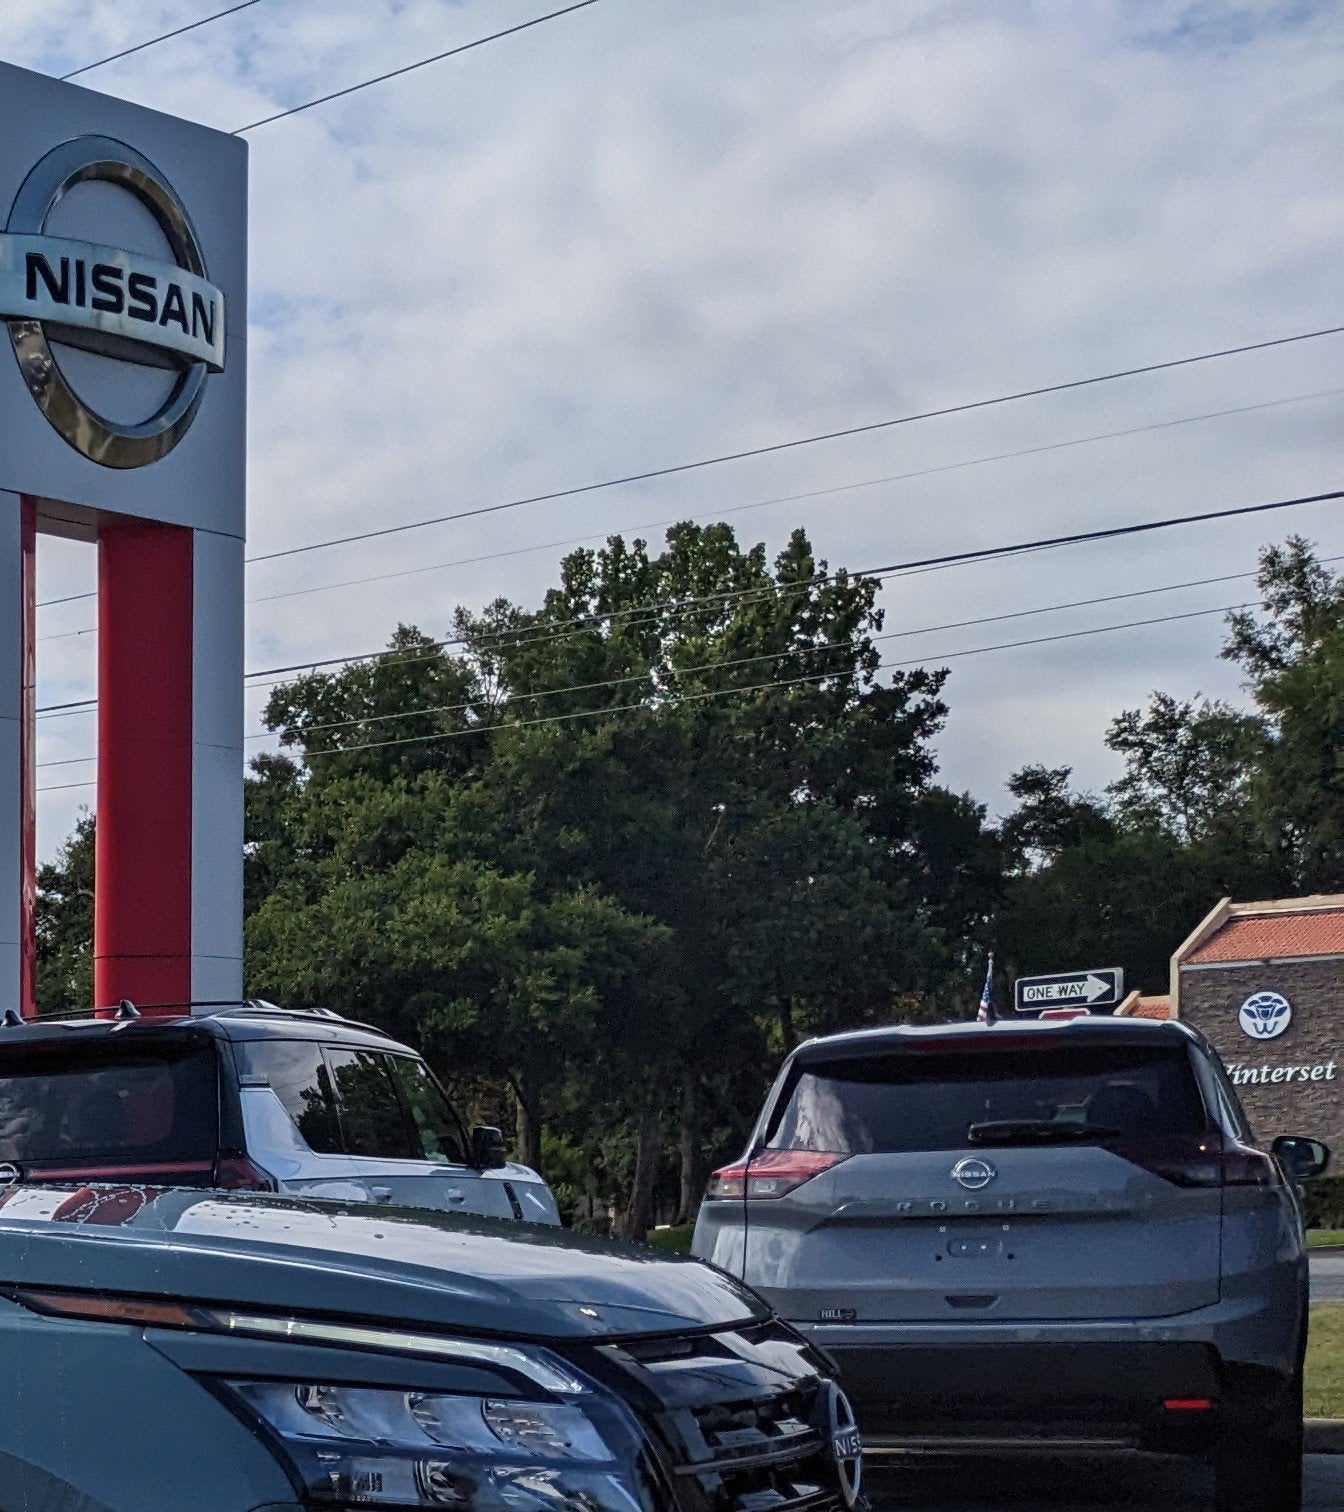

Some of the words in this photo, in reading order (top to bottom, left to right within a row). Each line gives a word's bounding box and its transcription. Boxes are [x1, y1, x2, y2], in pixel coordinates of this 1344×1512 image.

[25, 252, 215, 346] NISSAN
[1026, 986, 1053, 999] ONE
[1057, 983, 1085, 996] WAY
